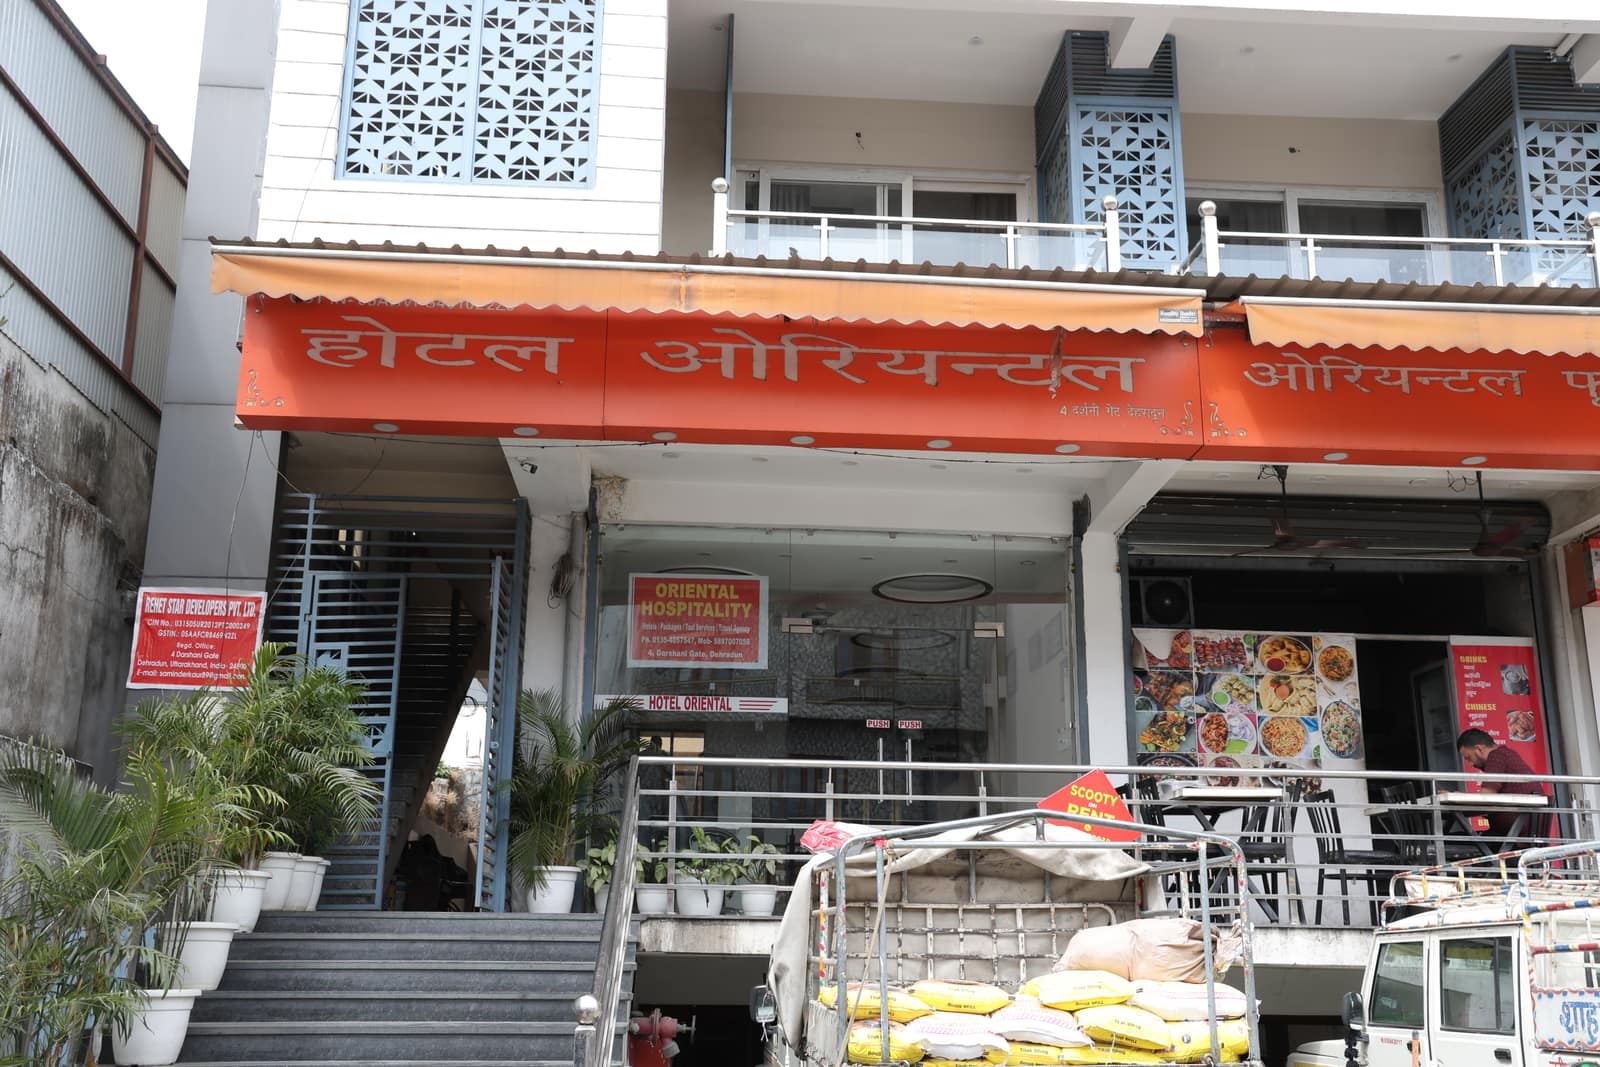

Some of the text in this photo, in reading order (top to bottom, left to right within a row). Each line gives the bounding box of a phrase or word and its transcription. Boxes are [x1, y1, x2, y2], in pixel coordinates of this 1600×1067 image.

[301, 316, 1146, 392] होटल ओरियन्टल
[1244, 352, 1527, 398] ओरियन्टल
[1060, 405, 1067, 416] 4
[656, 583, 739, 599] ORIENTAL
[167, 598, 184, 615] STAR
[185, 599, 227, 617] DEVELOPERS
[227, 601, 242, 617] PVT.
[243, 601, 256, 617] LTD.
[641, 601, 753, 618] HOSPITALITY
[656, 649, 688, 657] Darshani
[649, 695, 732, 711] HOTEL ORIENTAL
[1465, 703, 1496, 711] CHINESE
[868, 720, 888, 728] PUSH
[900, 720, 921, 728] PUSH
[1070, 785, 1118, 807] SCOOTY
